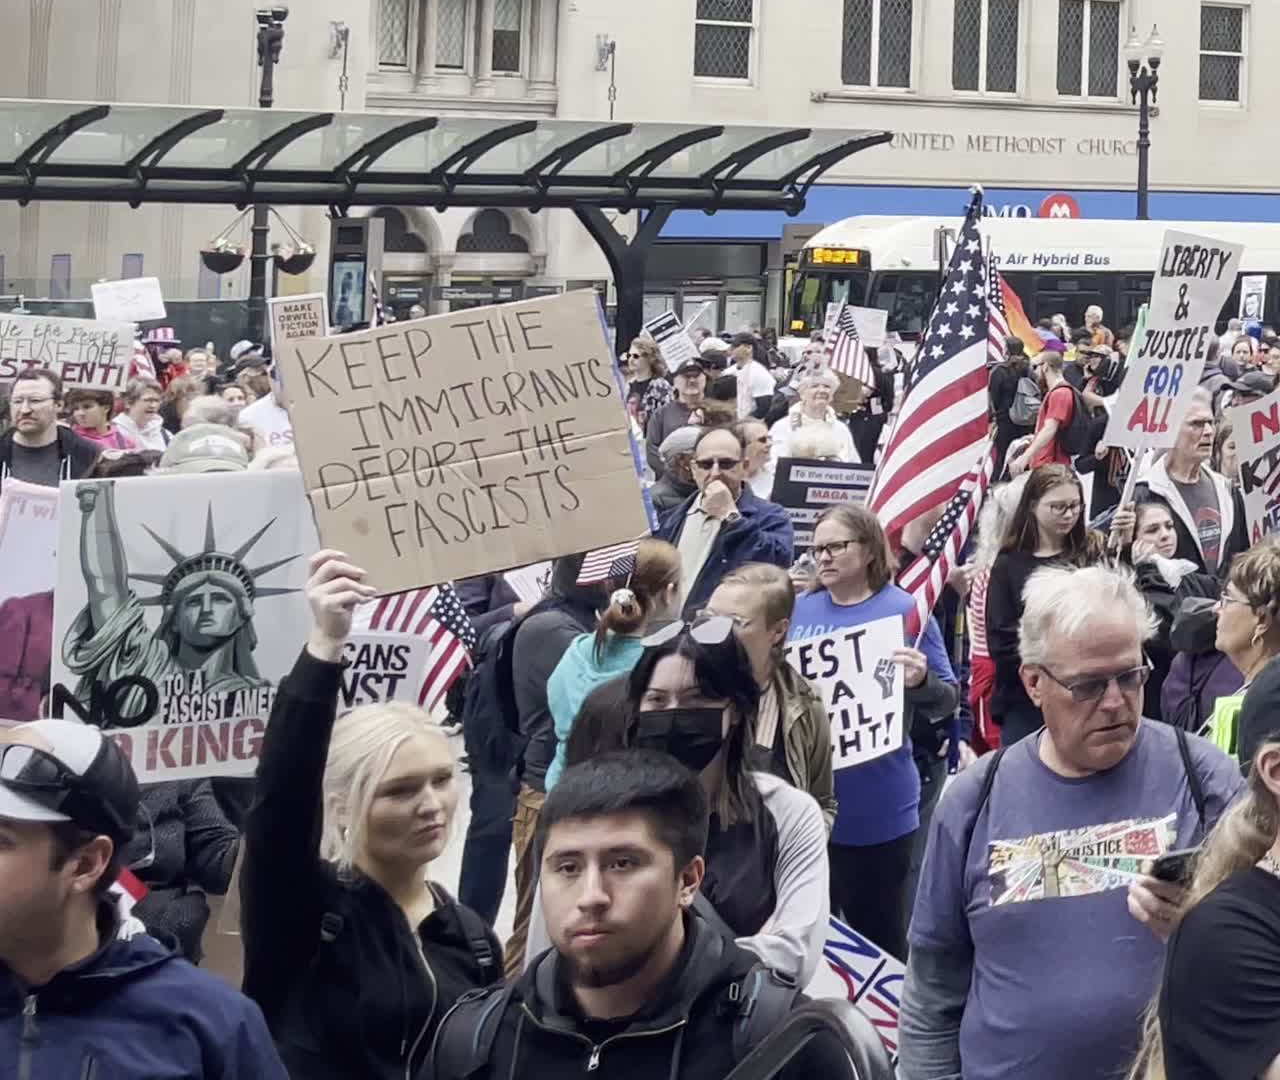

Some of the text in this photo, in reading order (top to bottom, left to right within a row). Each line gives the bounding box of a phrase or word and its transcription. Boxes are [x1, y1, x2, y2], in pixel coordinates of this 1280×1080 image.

[888, 132, 1140, 157] UNITED METHODIST CHURC
[984, 204, 1032, 219] MO
[1007, 253, 1027, 265] Air
[1032, 253, 1078, 266] Hybrid
[1081, 254, 1110, 265] Bus
[1160, 245, 1232, 280] LIBERTY
[279, 312, 319, 322] ORWELL
[284, 303, 312, 312] MAKE
[1174, 283, 1189, 320] &
[281, 321, 318, 331] FICTION
[286, 329, 316, 339] AGAIN
[296, 311, 553, 398] KEEP THE
[1137, 326, 1210, 361] JUSTICE
[1143, 364, 1183, 397] FOR
[339, 358, 612, 451] IMMIGRANTS
[1127, 397, 1172, 433] ALL
[319, 417, 588, 511] DEPORT THE
[795, 469, 805, 478] To
[808, 470, 822, 479] the
[825, 472, 843, 480] rest
[845, 472, 855, 481] of
[811, 489, 849, 500] MAGA
[384, 465, 580, 558] FASCISTS
[52, 670, 205, 729] NO TO A
[161, 692, 228, 726] FASCIST
[831, 680, 855, 705] A
